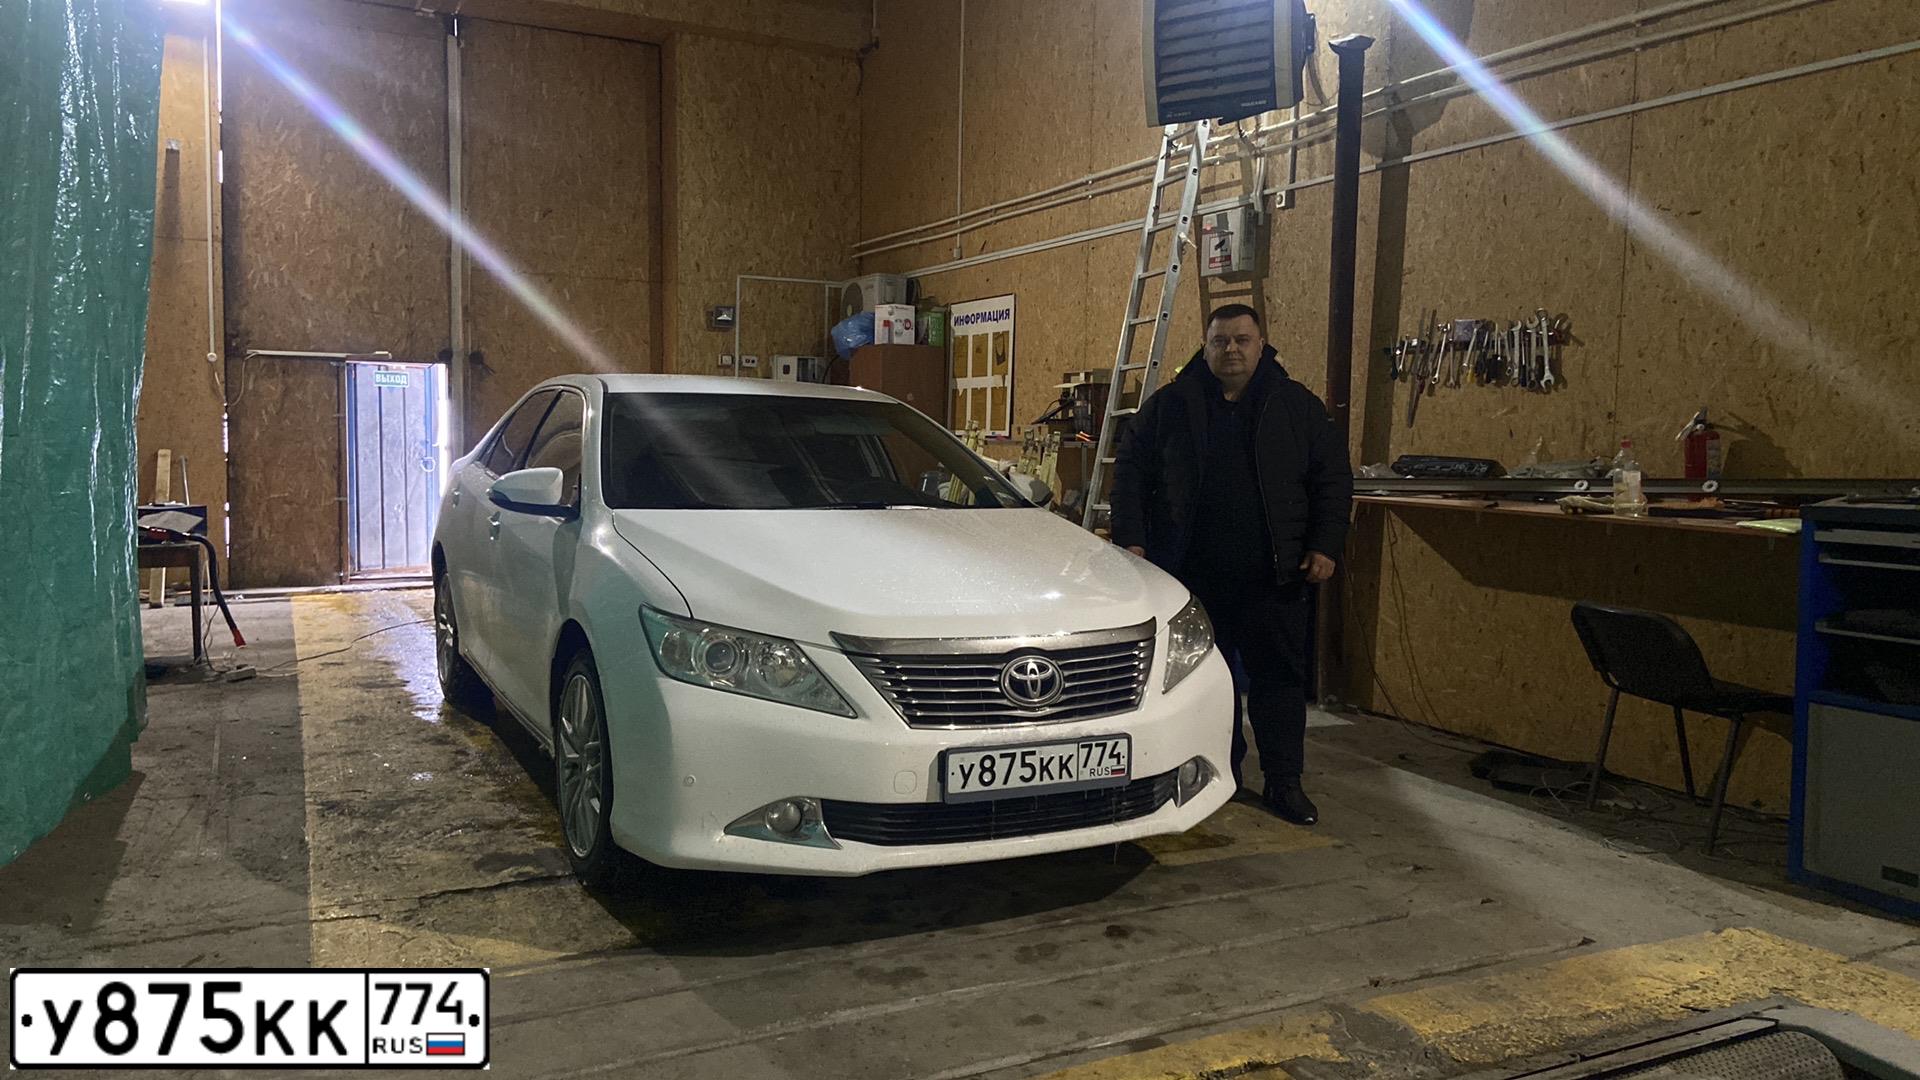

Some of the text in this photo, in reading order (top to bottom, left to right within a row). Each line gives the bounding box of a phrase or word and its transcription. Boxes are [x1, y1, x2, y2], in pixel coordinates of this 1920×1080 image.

[953, 308, 1010, 326] ИНФОРМАЦИЯ
[376, 373, 407, 385] ВЫХОД
[959, 741, 1121, 789] У875КК 774
[1089, 767, 1110, 777] RUS
